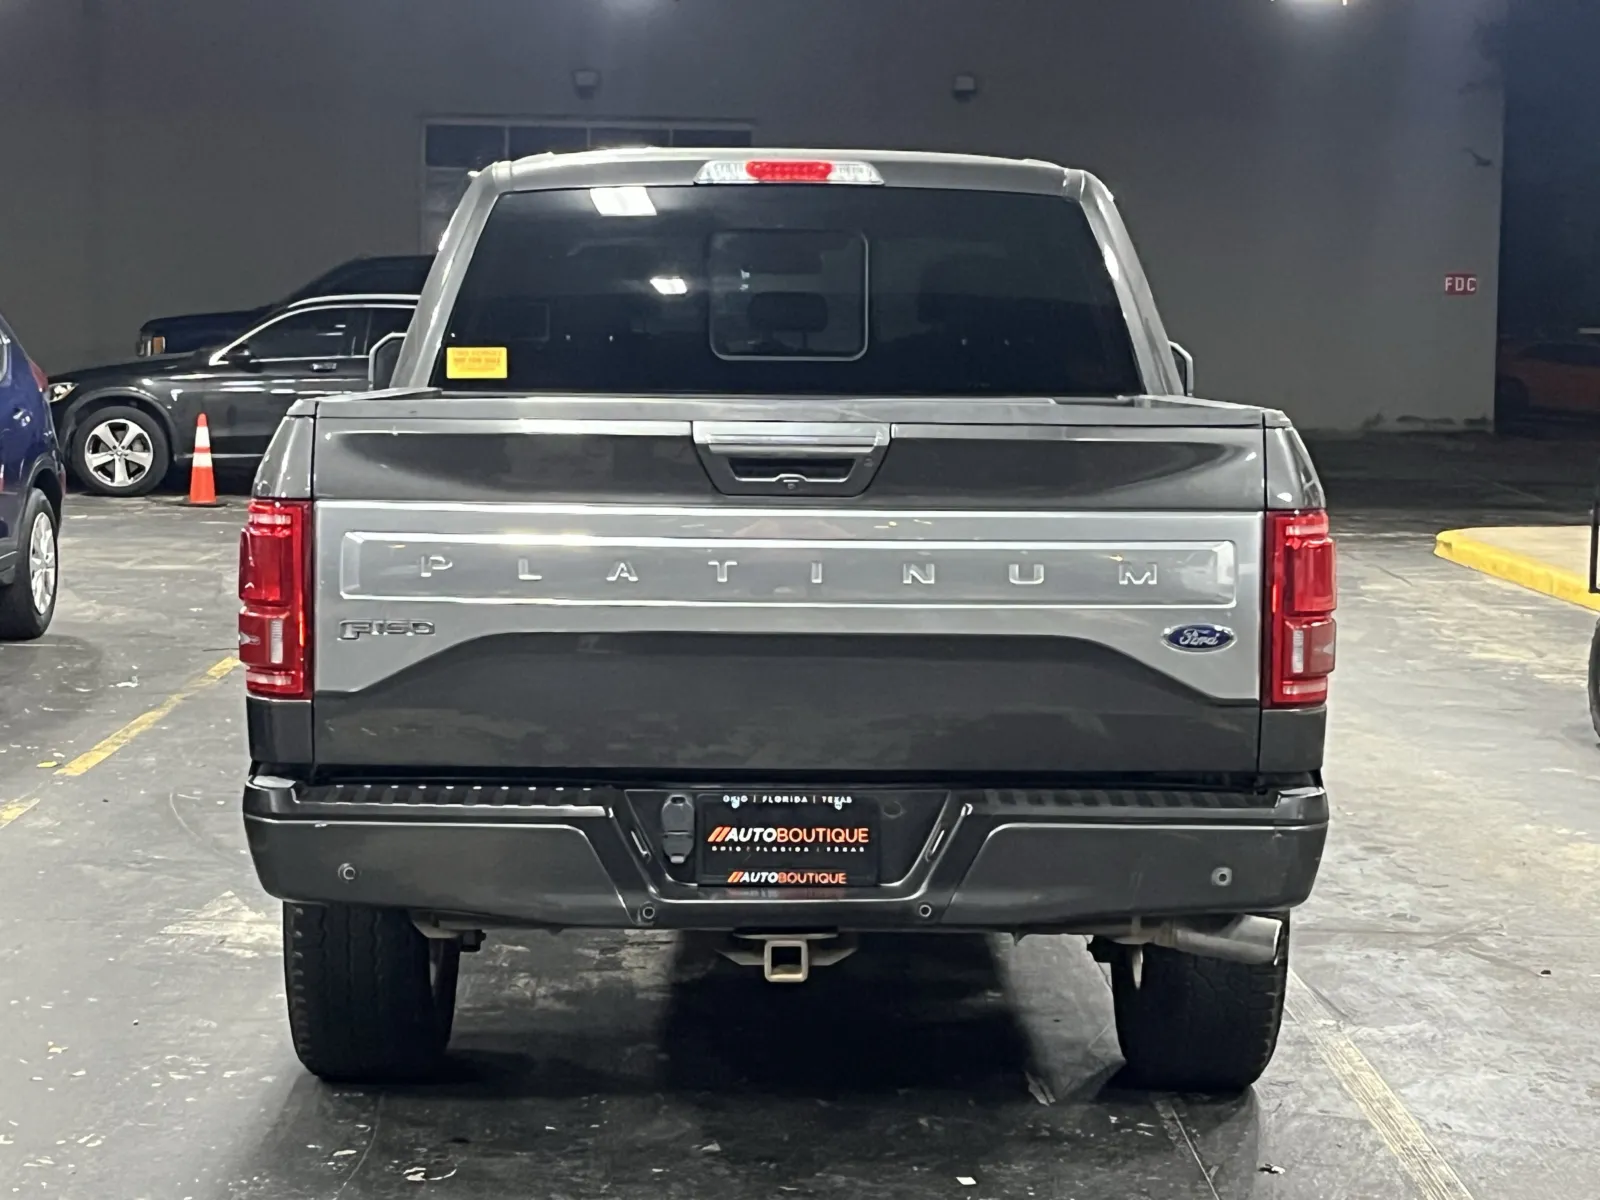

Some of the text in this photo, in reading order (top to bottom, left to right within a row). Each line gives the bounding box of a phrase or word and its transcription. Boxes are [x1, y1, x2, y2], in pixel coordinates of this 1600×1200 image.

[1445, 277, 1477, 291] FDC
[419, 555, 1158, 586] PLATINUM
[1179, 628, 1220, 646] Ford
[762, 795, 808, 804] FLORIDA
